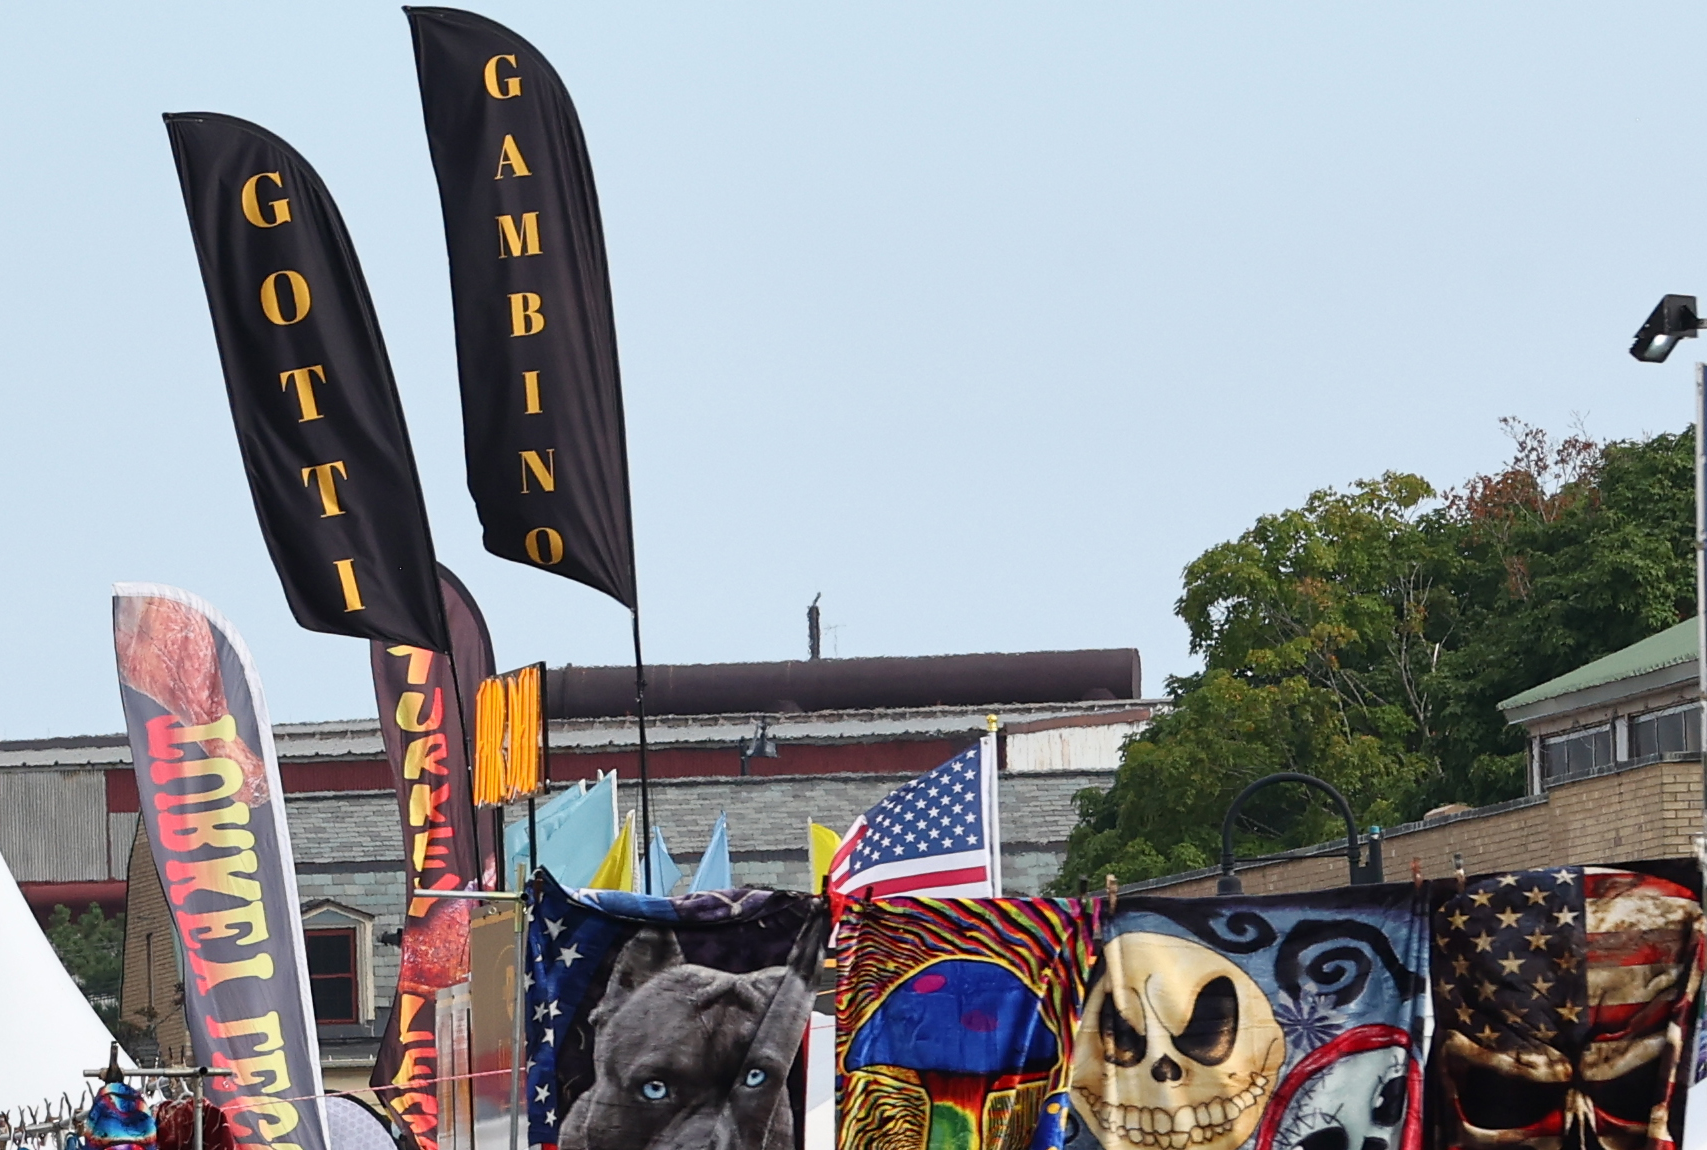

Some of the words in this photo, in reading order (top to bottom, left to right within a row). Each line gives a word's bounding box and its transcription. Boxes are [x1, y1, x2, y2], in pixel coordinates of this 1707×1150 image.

[240, 169, 368, 614] GOTTI
[483, 53, 565, 566] GAMBINO
[386, 644, 462, 919] TURKEY
